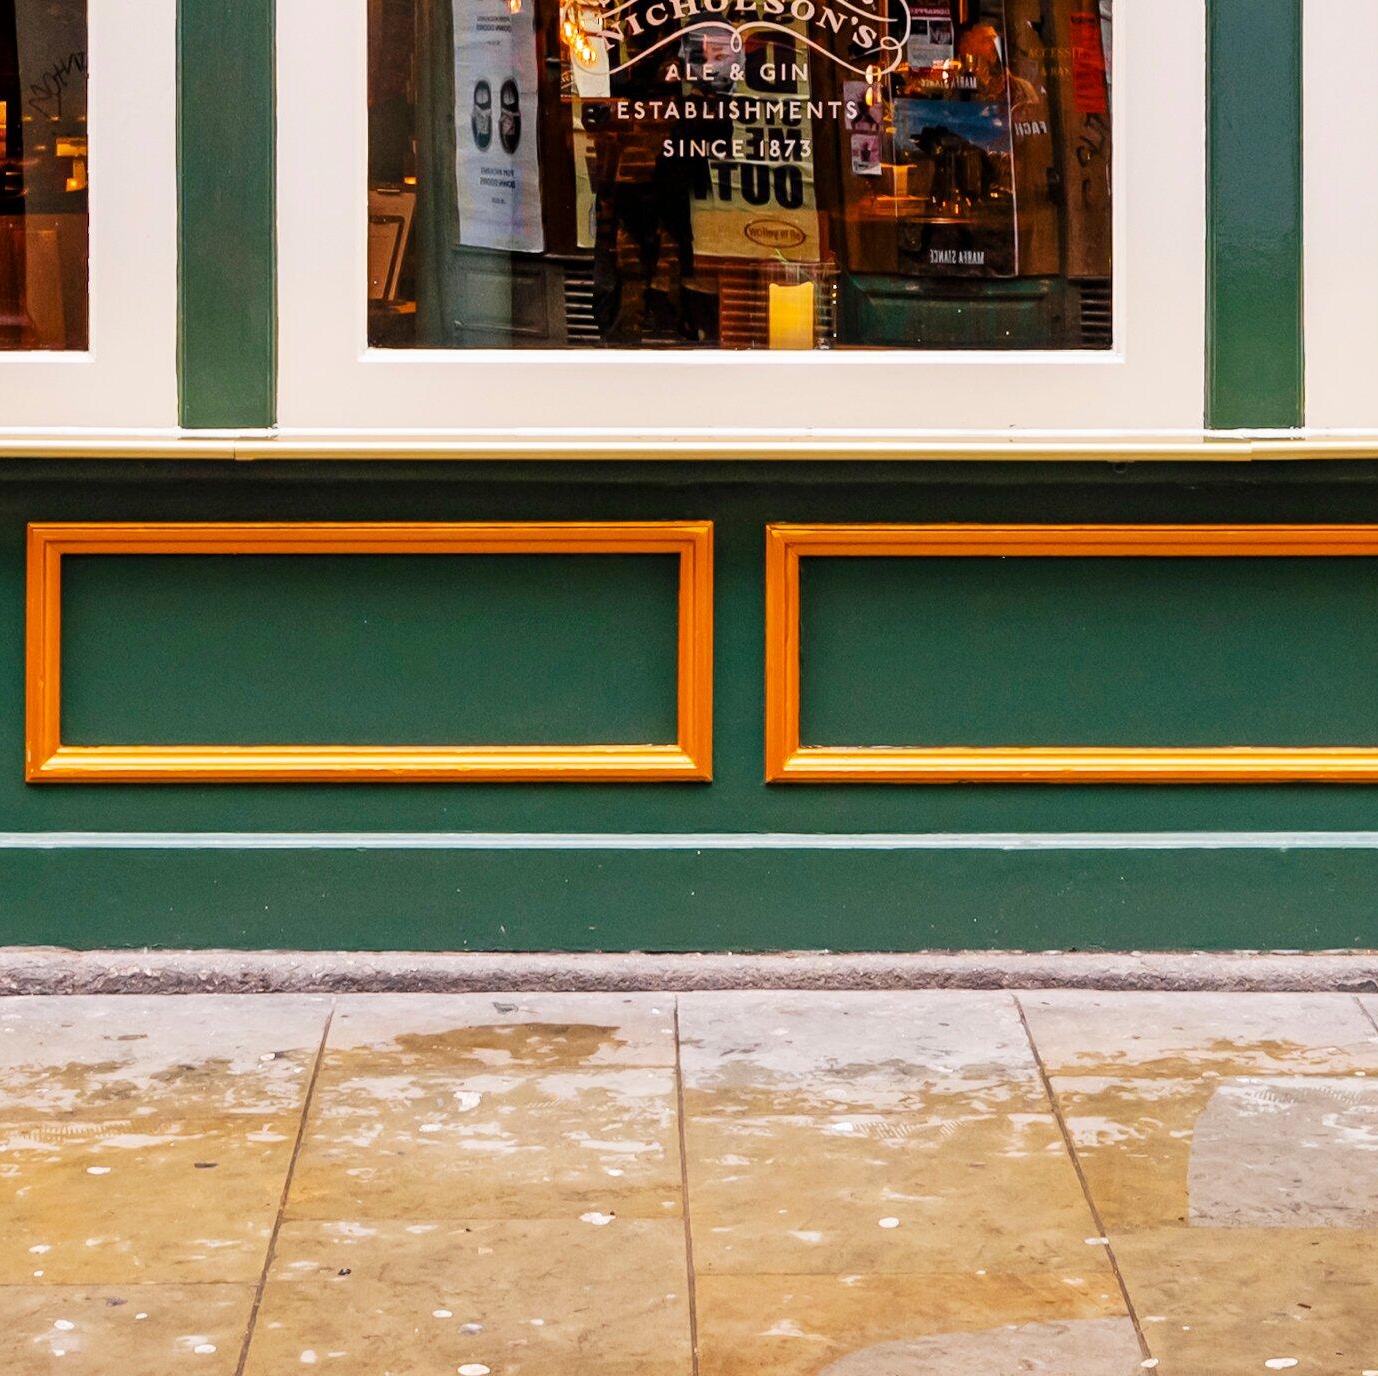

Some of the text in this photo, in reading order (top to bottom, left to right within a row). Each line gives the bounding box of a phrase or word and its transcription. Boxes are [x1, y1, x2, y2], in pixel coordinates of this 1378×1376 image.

[665, 63, 808, 81] ALE & GIN
[617, 101, 858, 119] ESTABLISHMENTS
[663, 139, 812, 157] SINCE 1873
